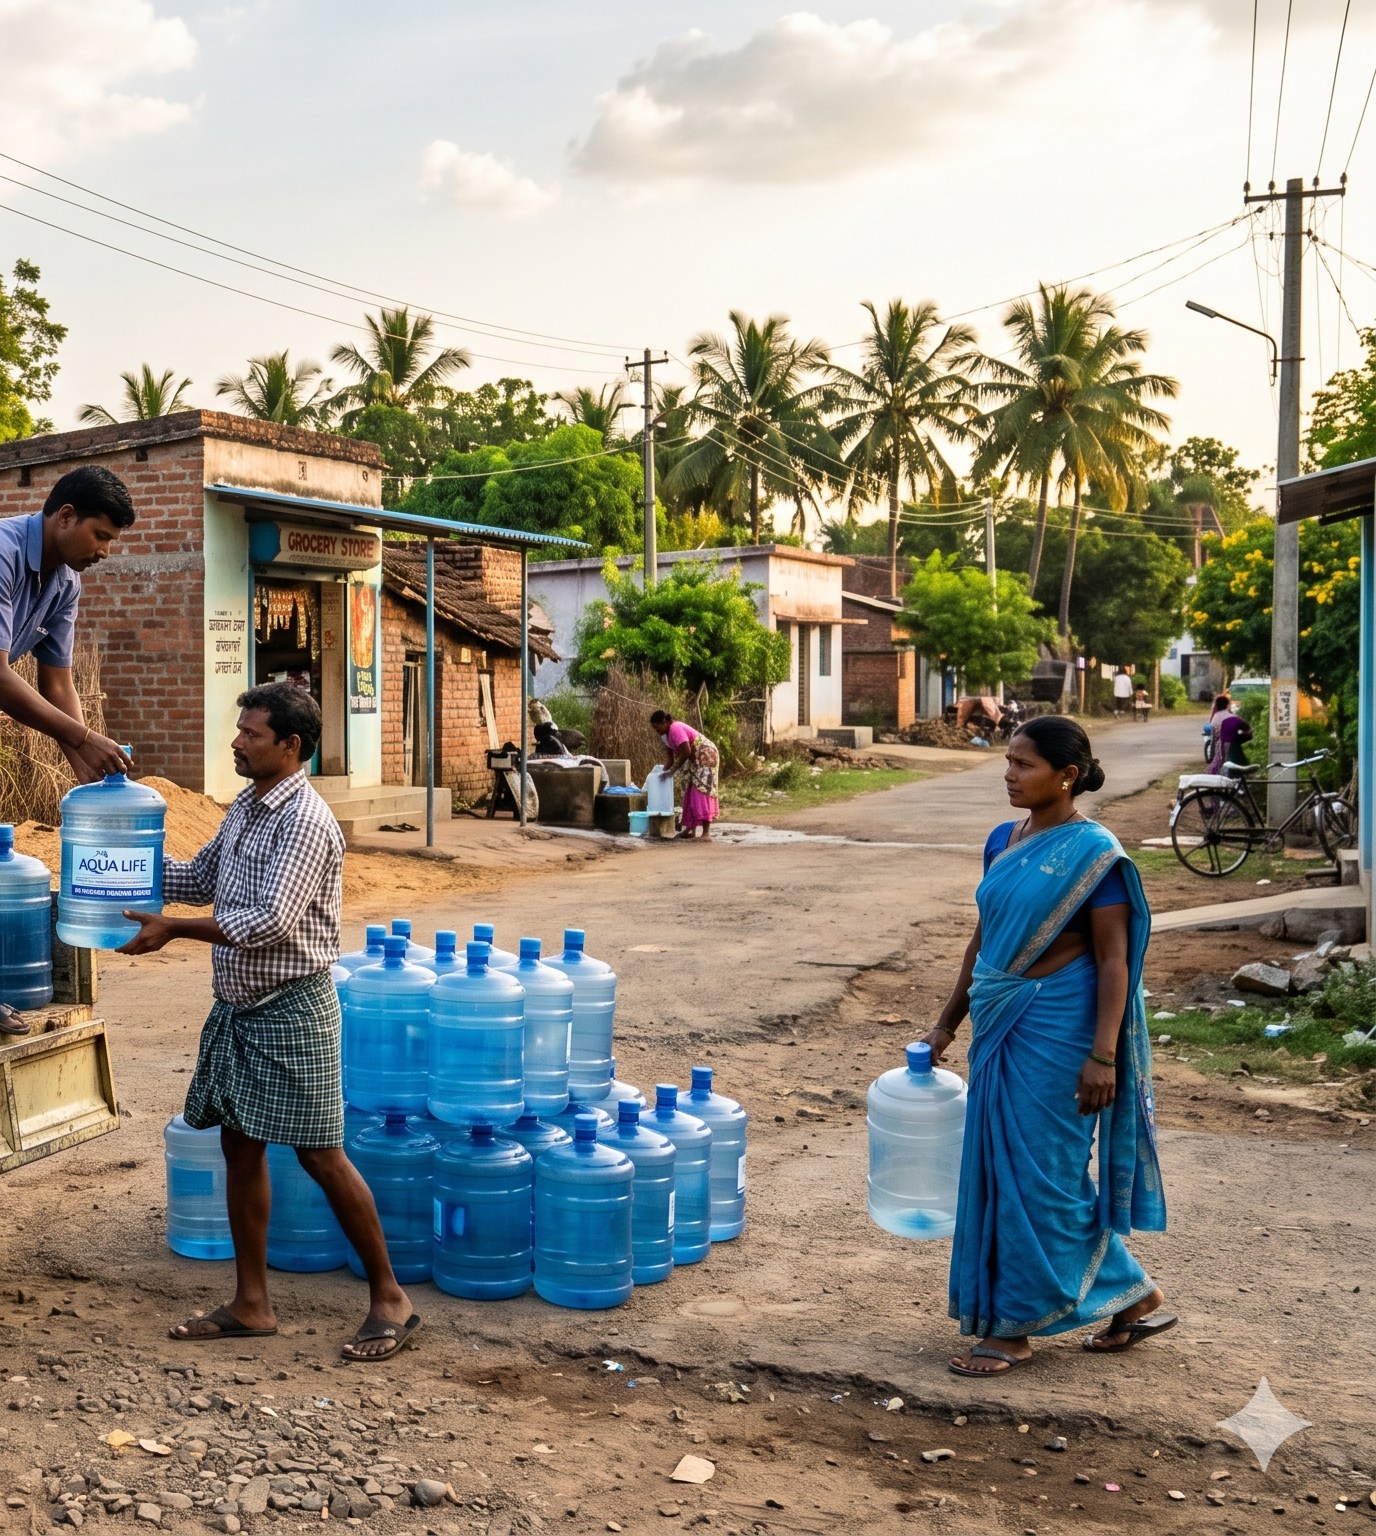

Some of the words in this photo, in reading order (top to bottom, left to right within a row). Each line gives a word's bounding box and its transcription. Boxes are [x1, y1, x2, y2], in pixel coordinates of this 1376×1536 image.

[288, 532, 337, 555] GROCERY
[341, 537, 374, 559] STORE
[78, 858, 118, 874] AQUA
[121, 859, 147, 872] LIFE
